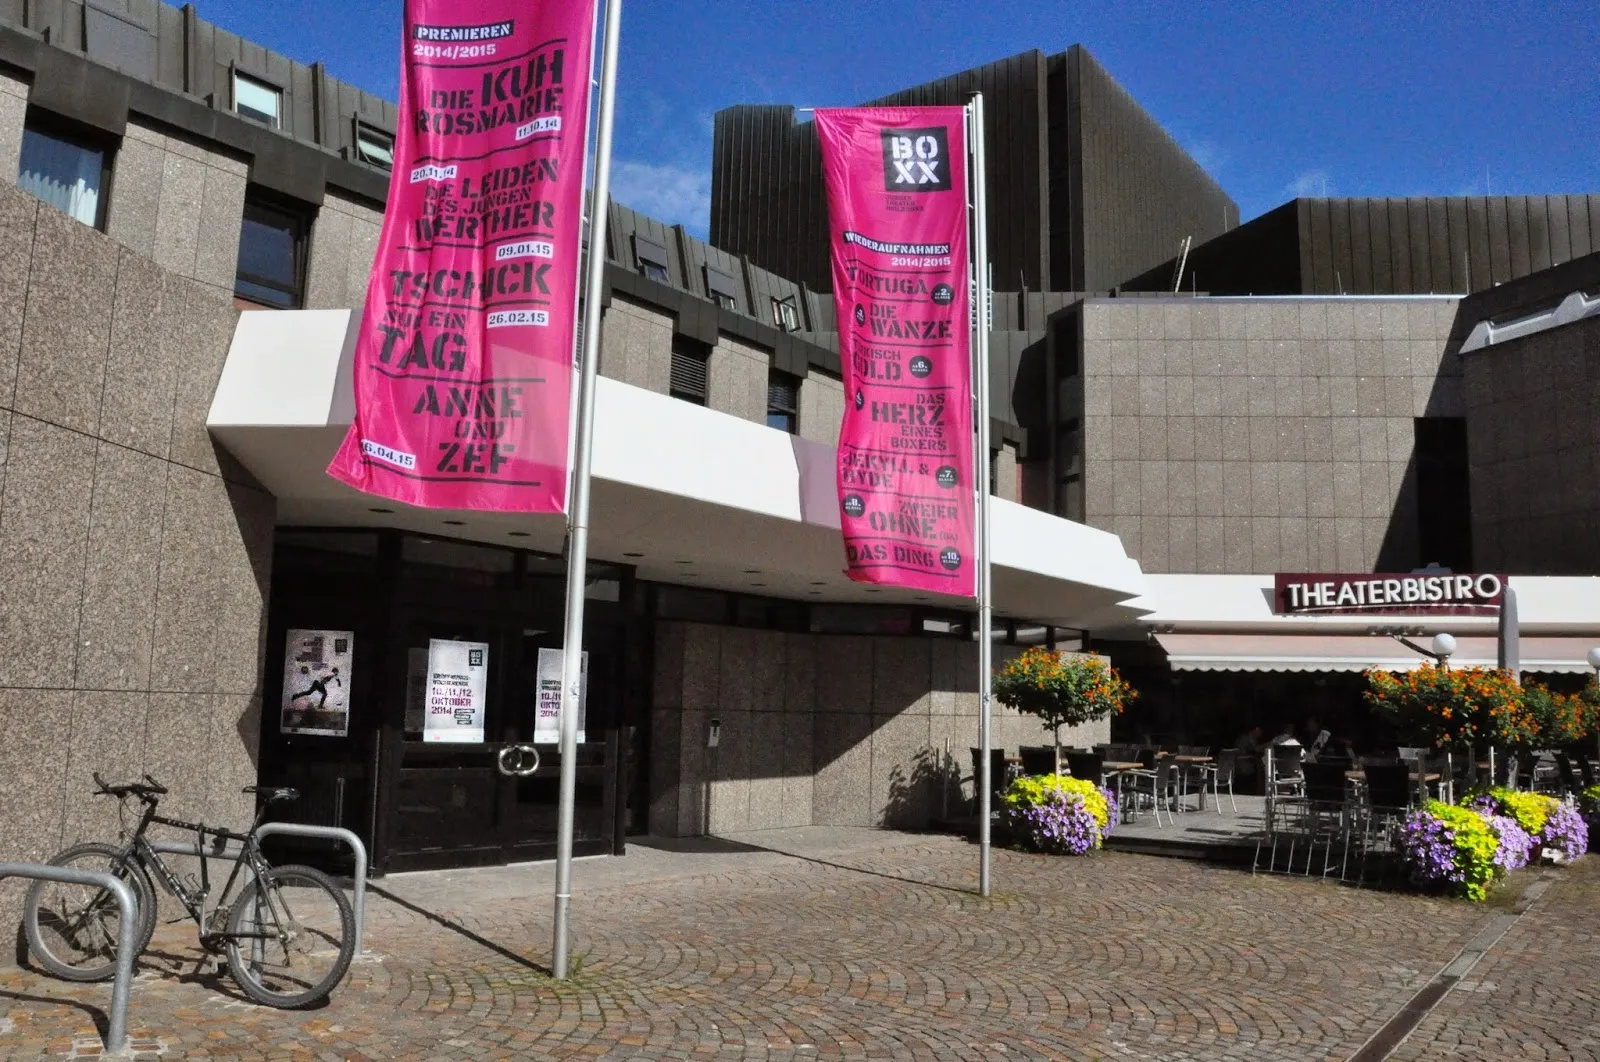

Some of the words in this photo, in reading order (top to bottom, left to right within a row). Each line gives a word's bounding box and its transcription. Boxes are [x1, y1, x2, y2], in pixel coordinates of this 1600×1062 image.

[417, 24, 511, 40] PREMIEREN
[413, 44, 496, 59] 2014/2015
[431, 89, 474, 110] DIE
[482, 49, 563, 106] KUH
[416, 88, 563, 136] ROSMARIE
[518, 118, 558, 138] 11.10.14
[892, 135, 938, 160] BO
[425, 184, 454, 200] DE
[461, 158, 558, 198] LEIDEN
[894, 161, 940, 184] XX
[463, 187, 532, 214] JUNGEN
[498, 244, 550, 257] 09.01.15
[845, 232, 949, 254] WIEDERAUFNAHMEN
[891, 256, 951, 267] 2014/2015
[390, 262, 552, 301] TSCHICK
[847, 267, 928, 295] TORTUGA
[429, 311, 466, 329] EIN
[488, 313, 546, 325] 26.02.15
[870, 303, 897, 319] DIE
[870, 318, 953, 339] WANZE
[377, 323, 467, 372] TAG
[413, 384, 524, 418] ANNE
[916, 393, 945, 404] DAS
[871, 401, 945, 426] HERZ
[454, 421, 505, 439] UND
[901, 426, 943, 438] EINES
[890, 437, 947, 451] BOXERS
[436, 442, 515, 474] ZEF
[843, 451, 914, 473] JEKYLL
[919, 463, 929, 475] &
[843, 468, 894, 488] HYDE
[900, 501, 958, 519] ZWEIER
[869, 511, 937, 539] OHNE
[846, 545, 888, 562] DAS
[894, 546, 934, 568] DING
[1287, 574, 1501, 607] THEATERBISTRO
[431, 697, 472, 707] OKTOBER
[431, 706, 452, 715] 2014
